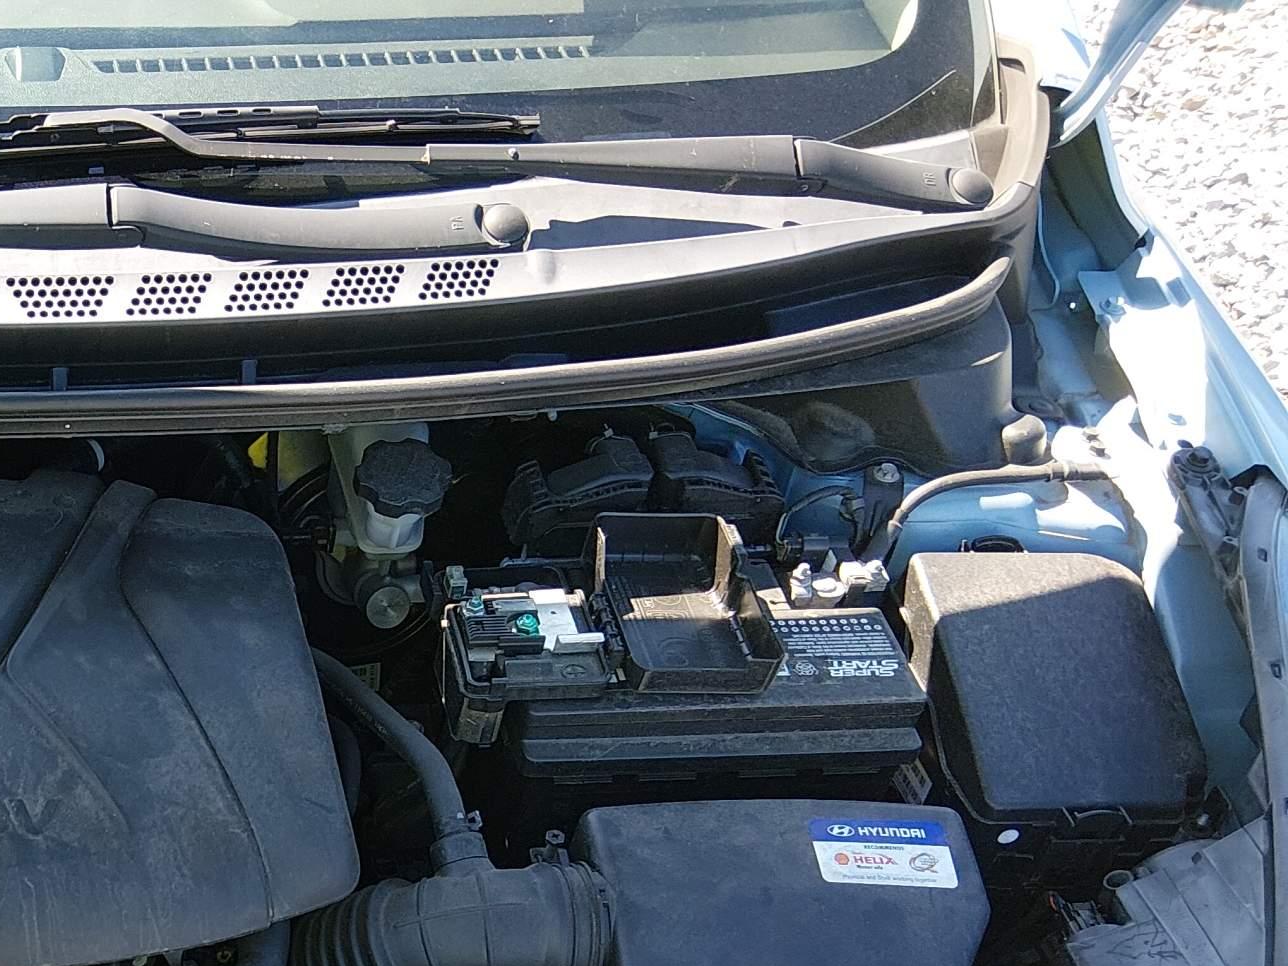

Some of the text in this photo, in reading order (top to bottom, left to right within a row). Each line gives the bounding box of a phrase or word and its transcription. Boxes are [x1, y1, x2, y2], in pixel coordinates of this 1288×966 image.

[827, 659, 899, 669] START
[830, 668, 895, 677] SUPER
[858, 827, 927, 839] HYUNDAI
[852, 855, 897, 866] HELIX
